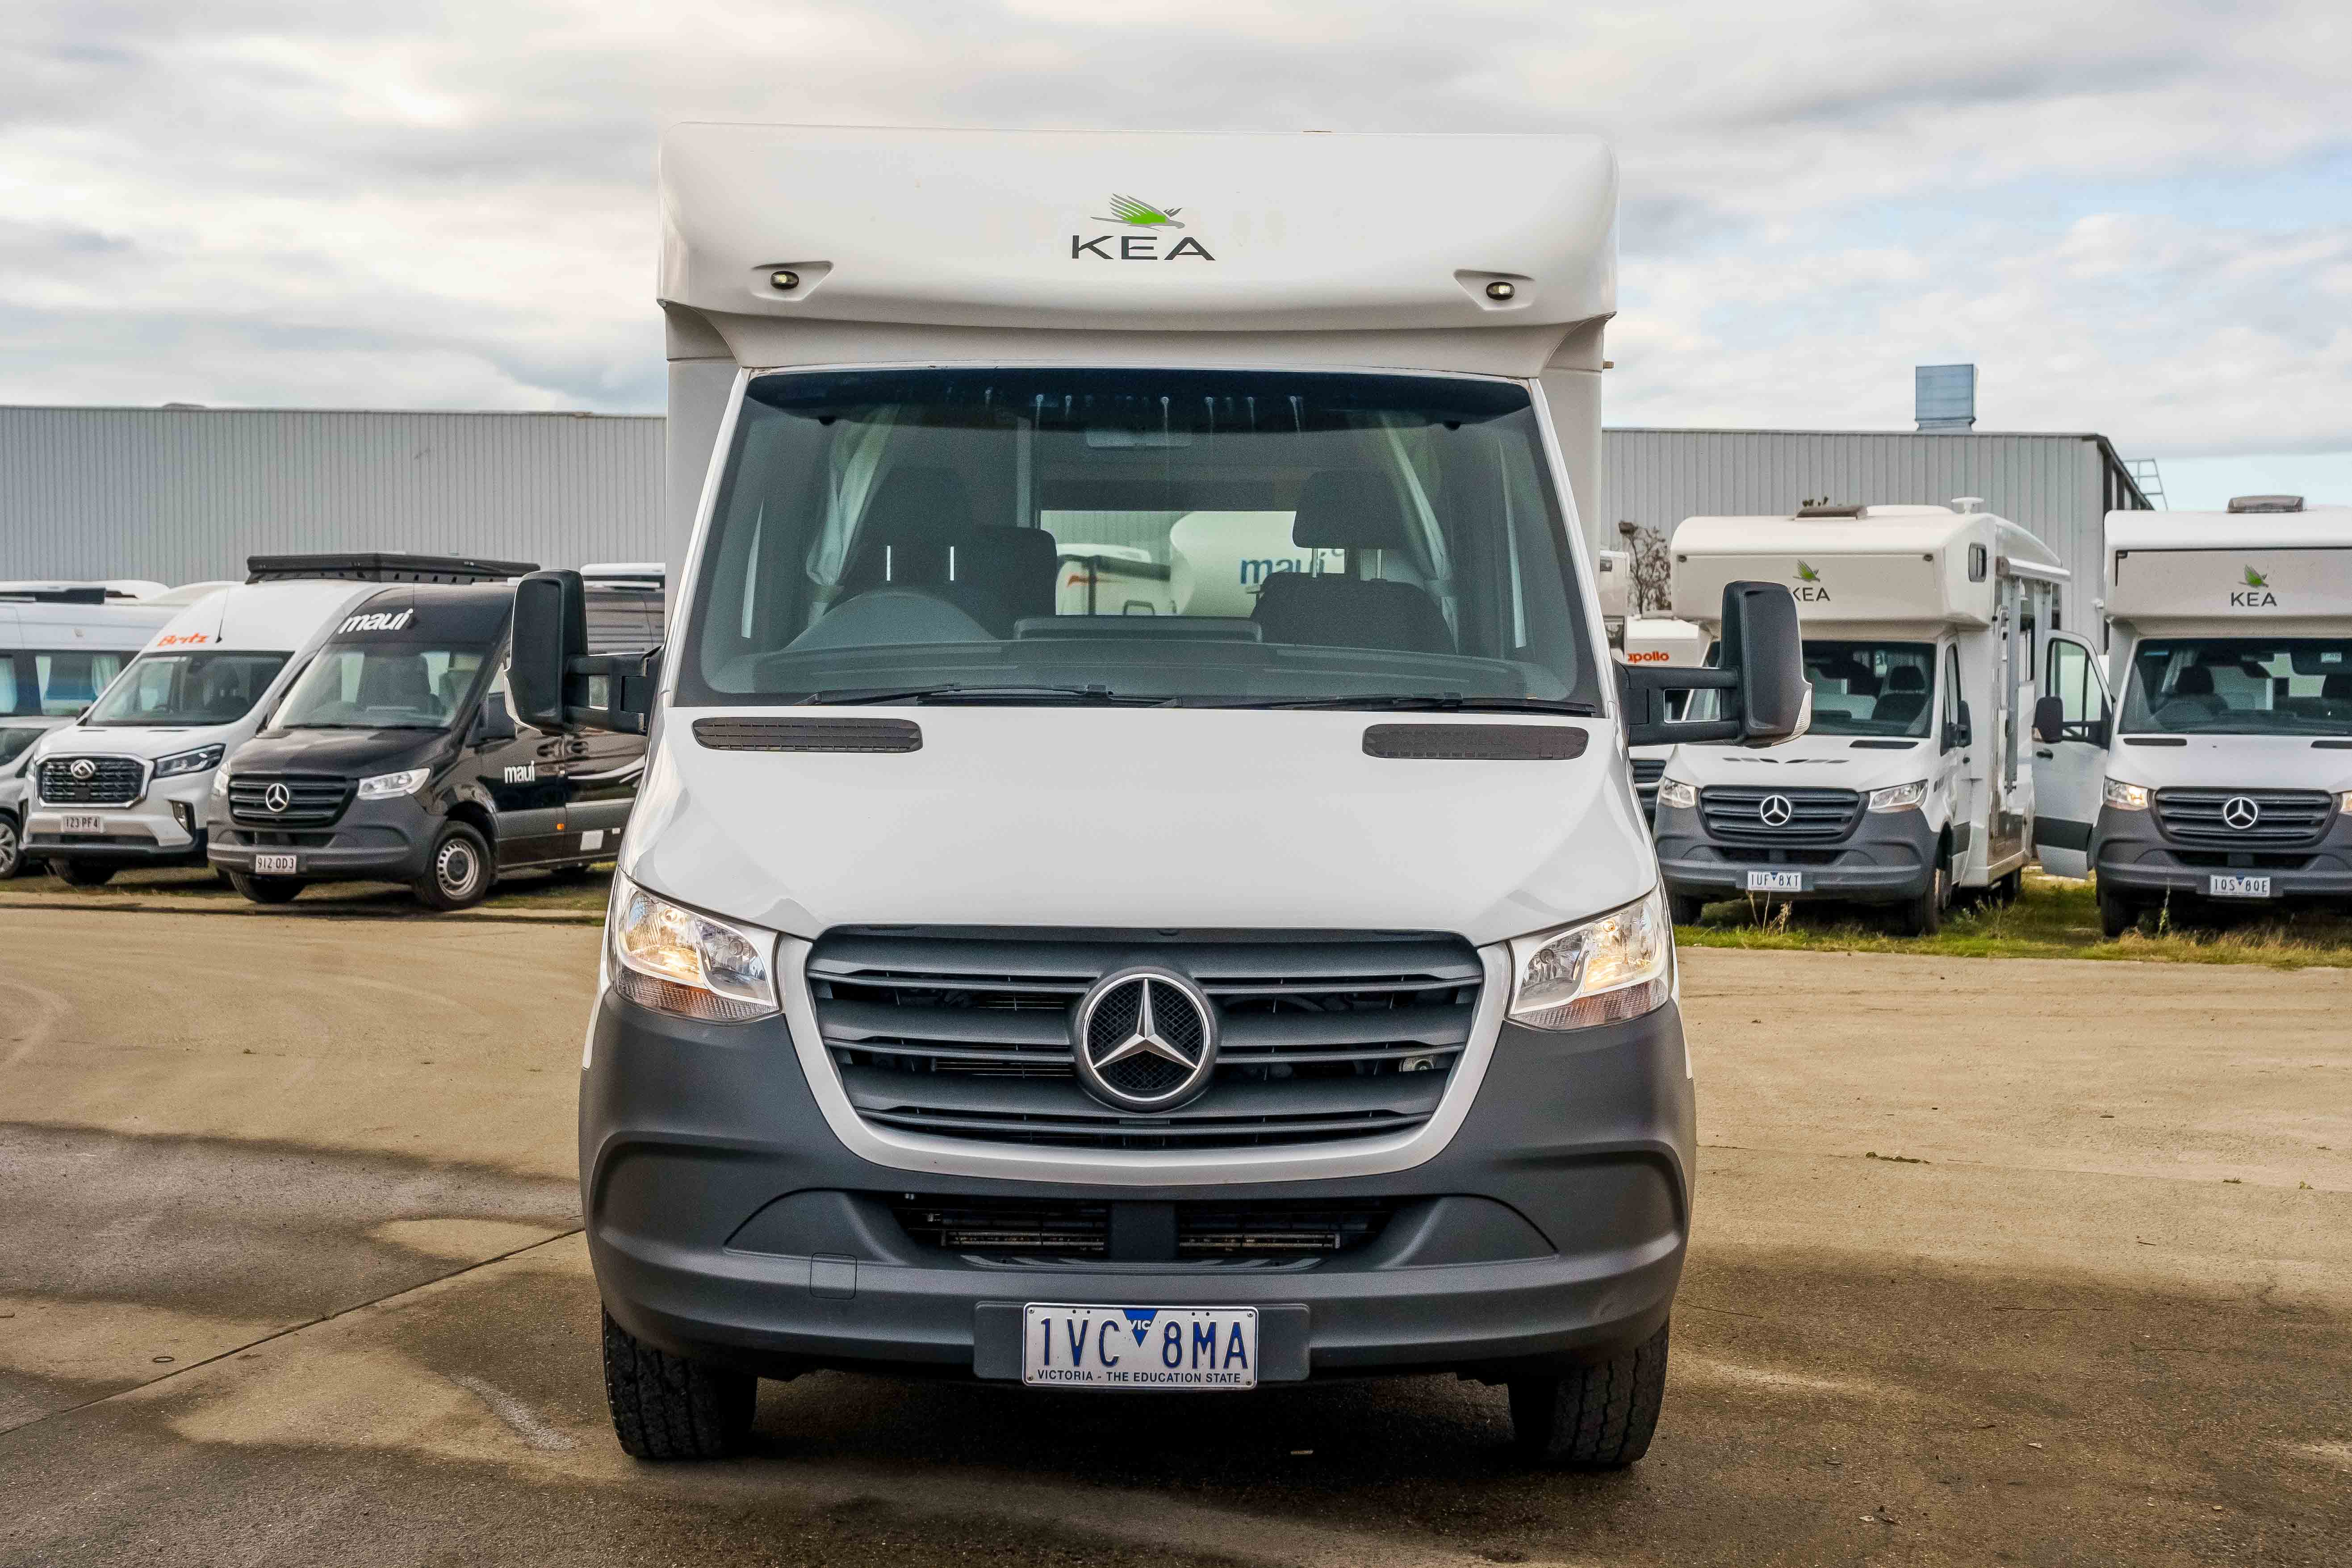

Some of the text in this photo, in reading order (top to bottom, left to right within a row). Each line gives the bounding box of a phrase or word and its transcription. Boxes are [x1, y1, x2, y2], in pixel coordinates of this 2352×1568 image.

[1072, 234, 1216, 261] KEA
[2231, 592, 2277, 607] KEA
[338, 608, 414, 635] maui
[504, 760, 536, 784] maui
[1127, 1319, 1152, 1330] VIC
[1040, 1317, 1249, 1370] 1VC 8MA
[1037, 1369, 1093, 1381] VICTORIA
[1106, 1371, 1129, 1382] THE
[1133, 1371, 1201, 1383] EDUCATION
[1205, 1372, 1241, 1384] STATE
